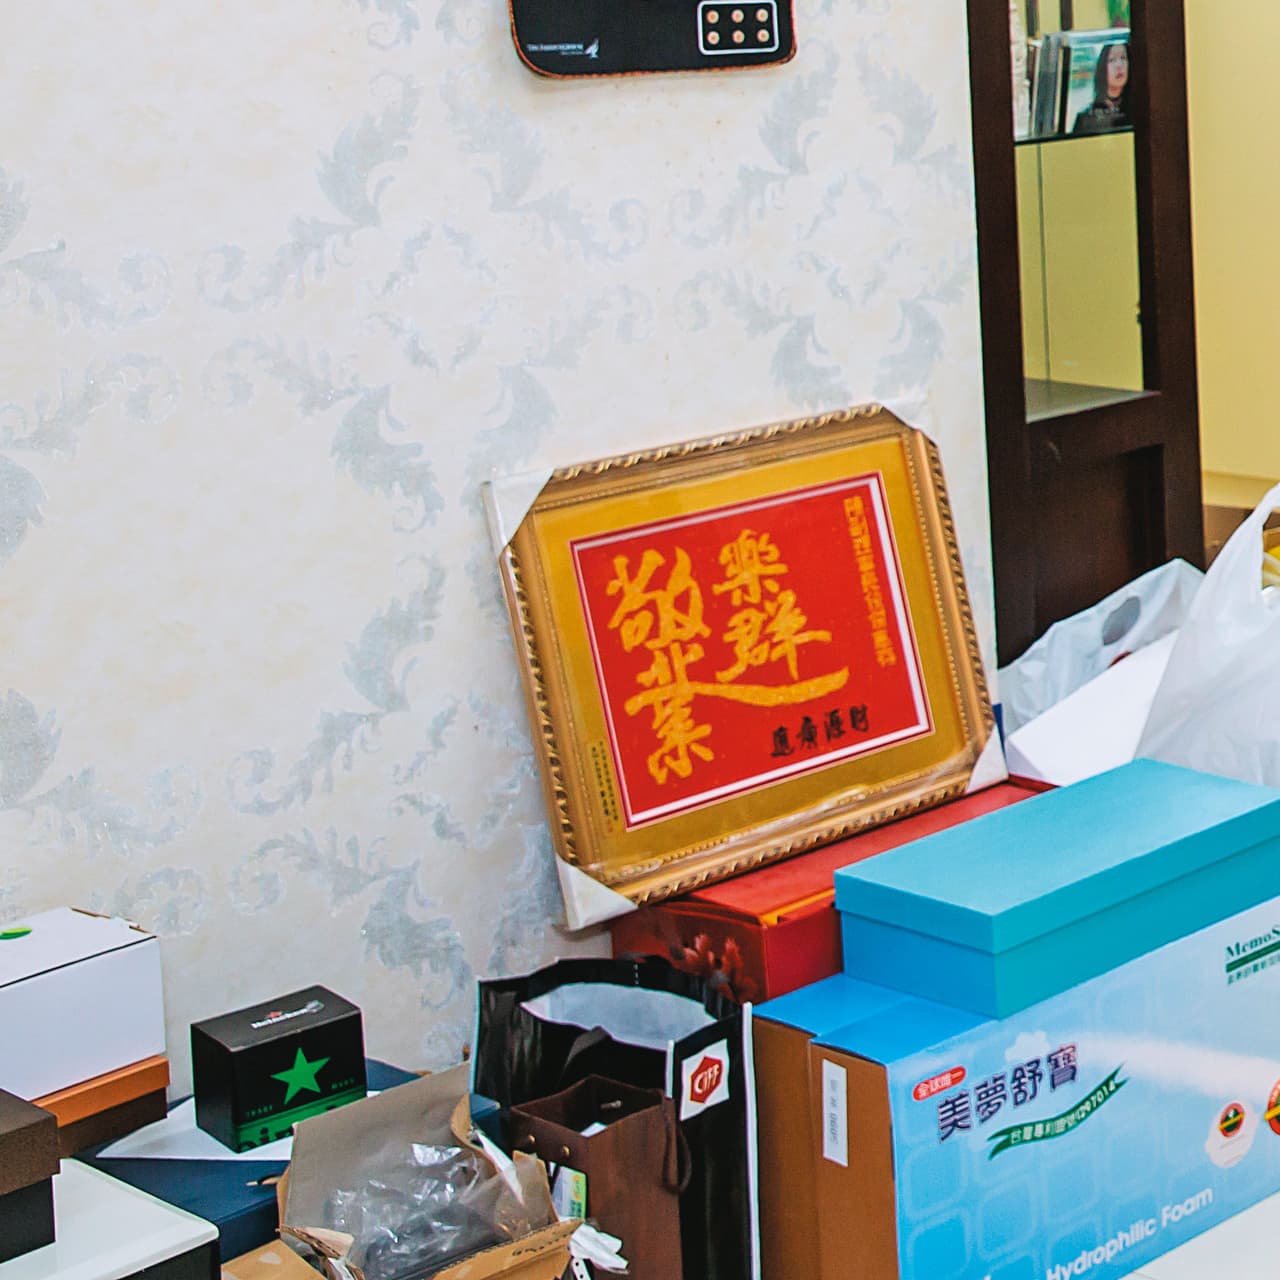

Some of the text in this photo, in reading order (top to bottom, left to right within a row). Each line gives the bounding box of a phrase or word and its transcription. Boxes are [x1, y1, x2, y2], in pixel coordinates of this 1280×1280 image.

[936, 1042, 1079, 1145] 美夢舒寶
[1046, 1187, 1214, 1280] Hydrophilic Foam
